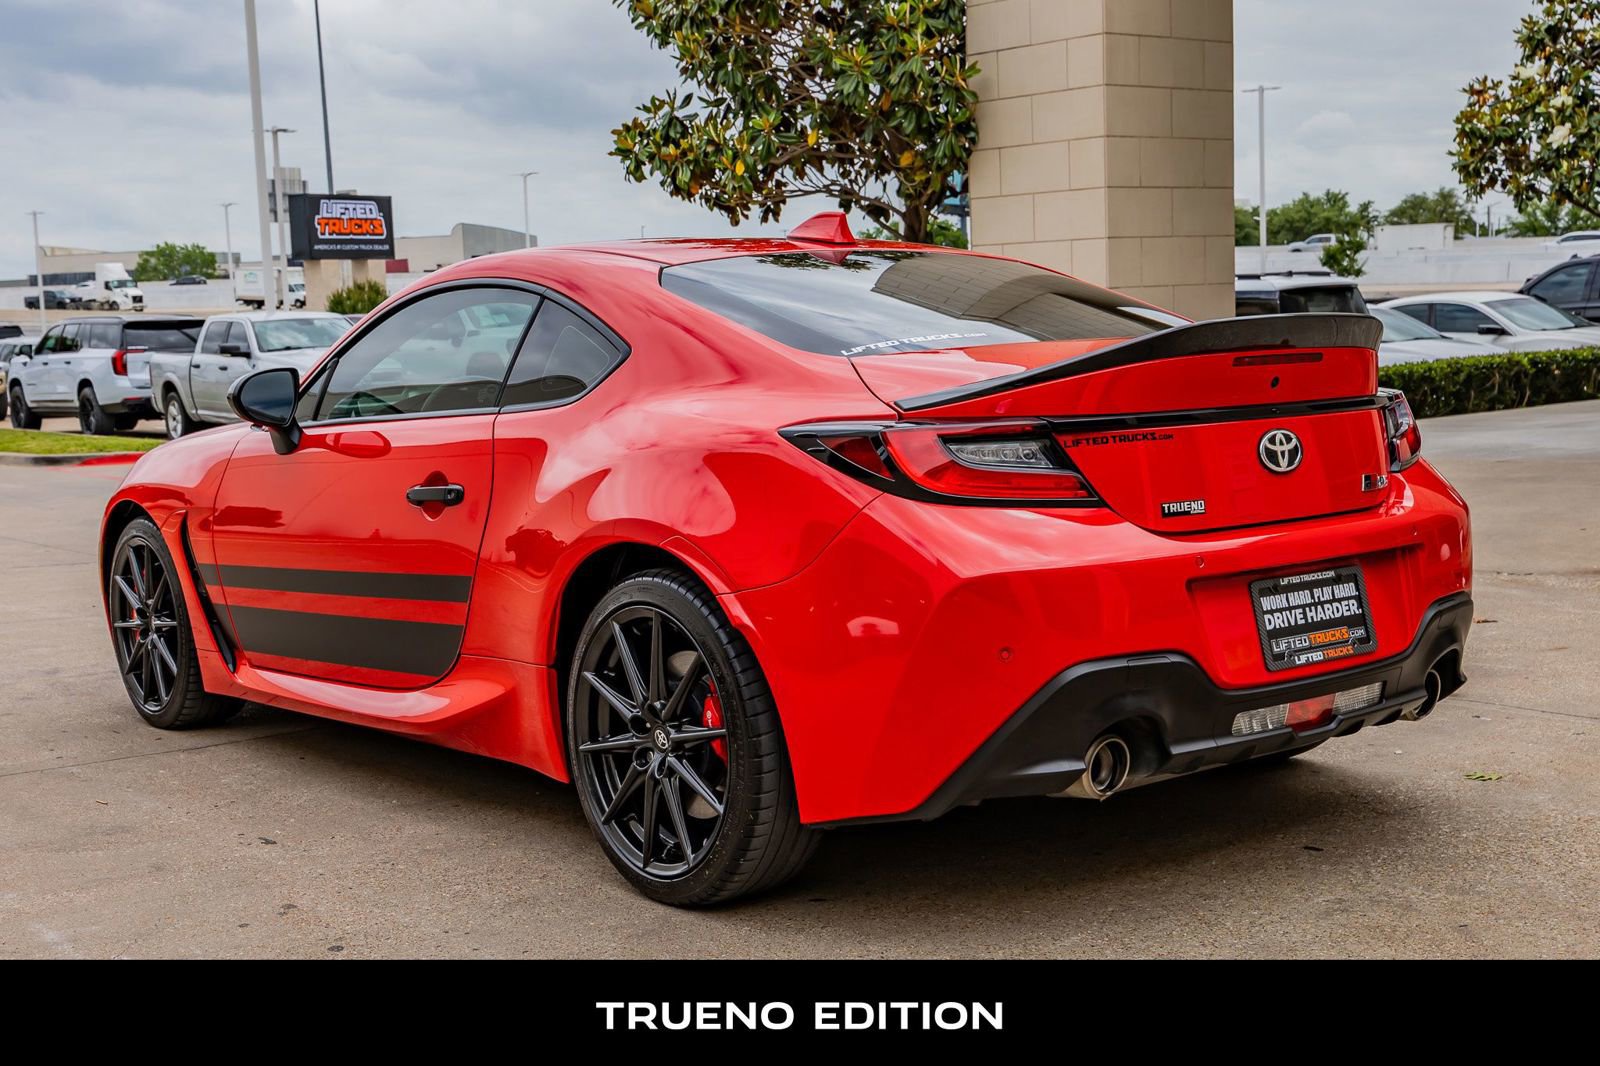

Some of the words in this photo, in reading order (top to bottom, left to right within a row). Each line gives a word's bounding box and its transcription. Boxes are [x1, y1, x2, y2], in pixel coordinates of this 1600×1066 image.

[321, 201, 378, 219] LIFTED
[317, 218, 384, 236] TRUCKS
[841, 340, 900, 356] LIFTED
[1063, 435, 1109, 449] LIFTED
[1162, 500, 1205, 513] TRUENO
[1260, 593, 1288, 611] WORK
[1288, 589, 1314, 607] HARD.
[1313, 585, 1334, 603] PLAY
[1334, 582, 1359, 599] HARD.
[1264, 609, 1305, 631] DRIVE
[1306, 599, 1363, 623] HARDER.
[1272, 636, 1309, 652] LIFTED
[1295, 651, 1323, 665] LIFTED
[1323, 645, 1354, 659] TRUCKS
